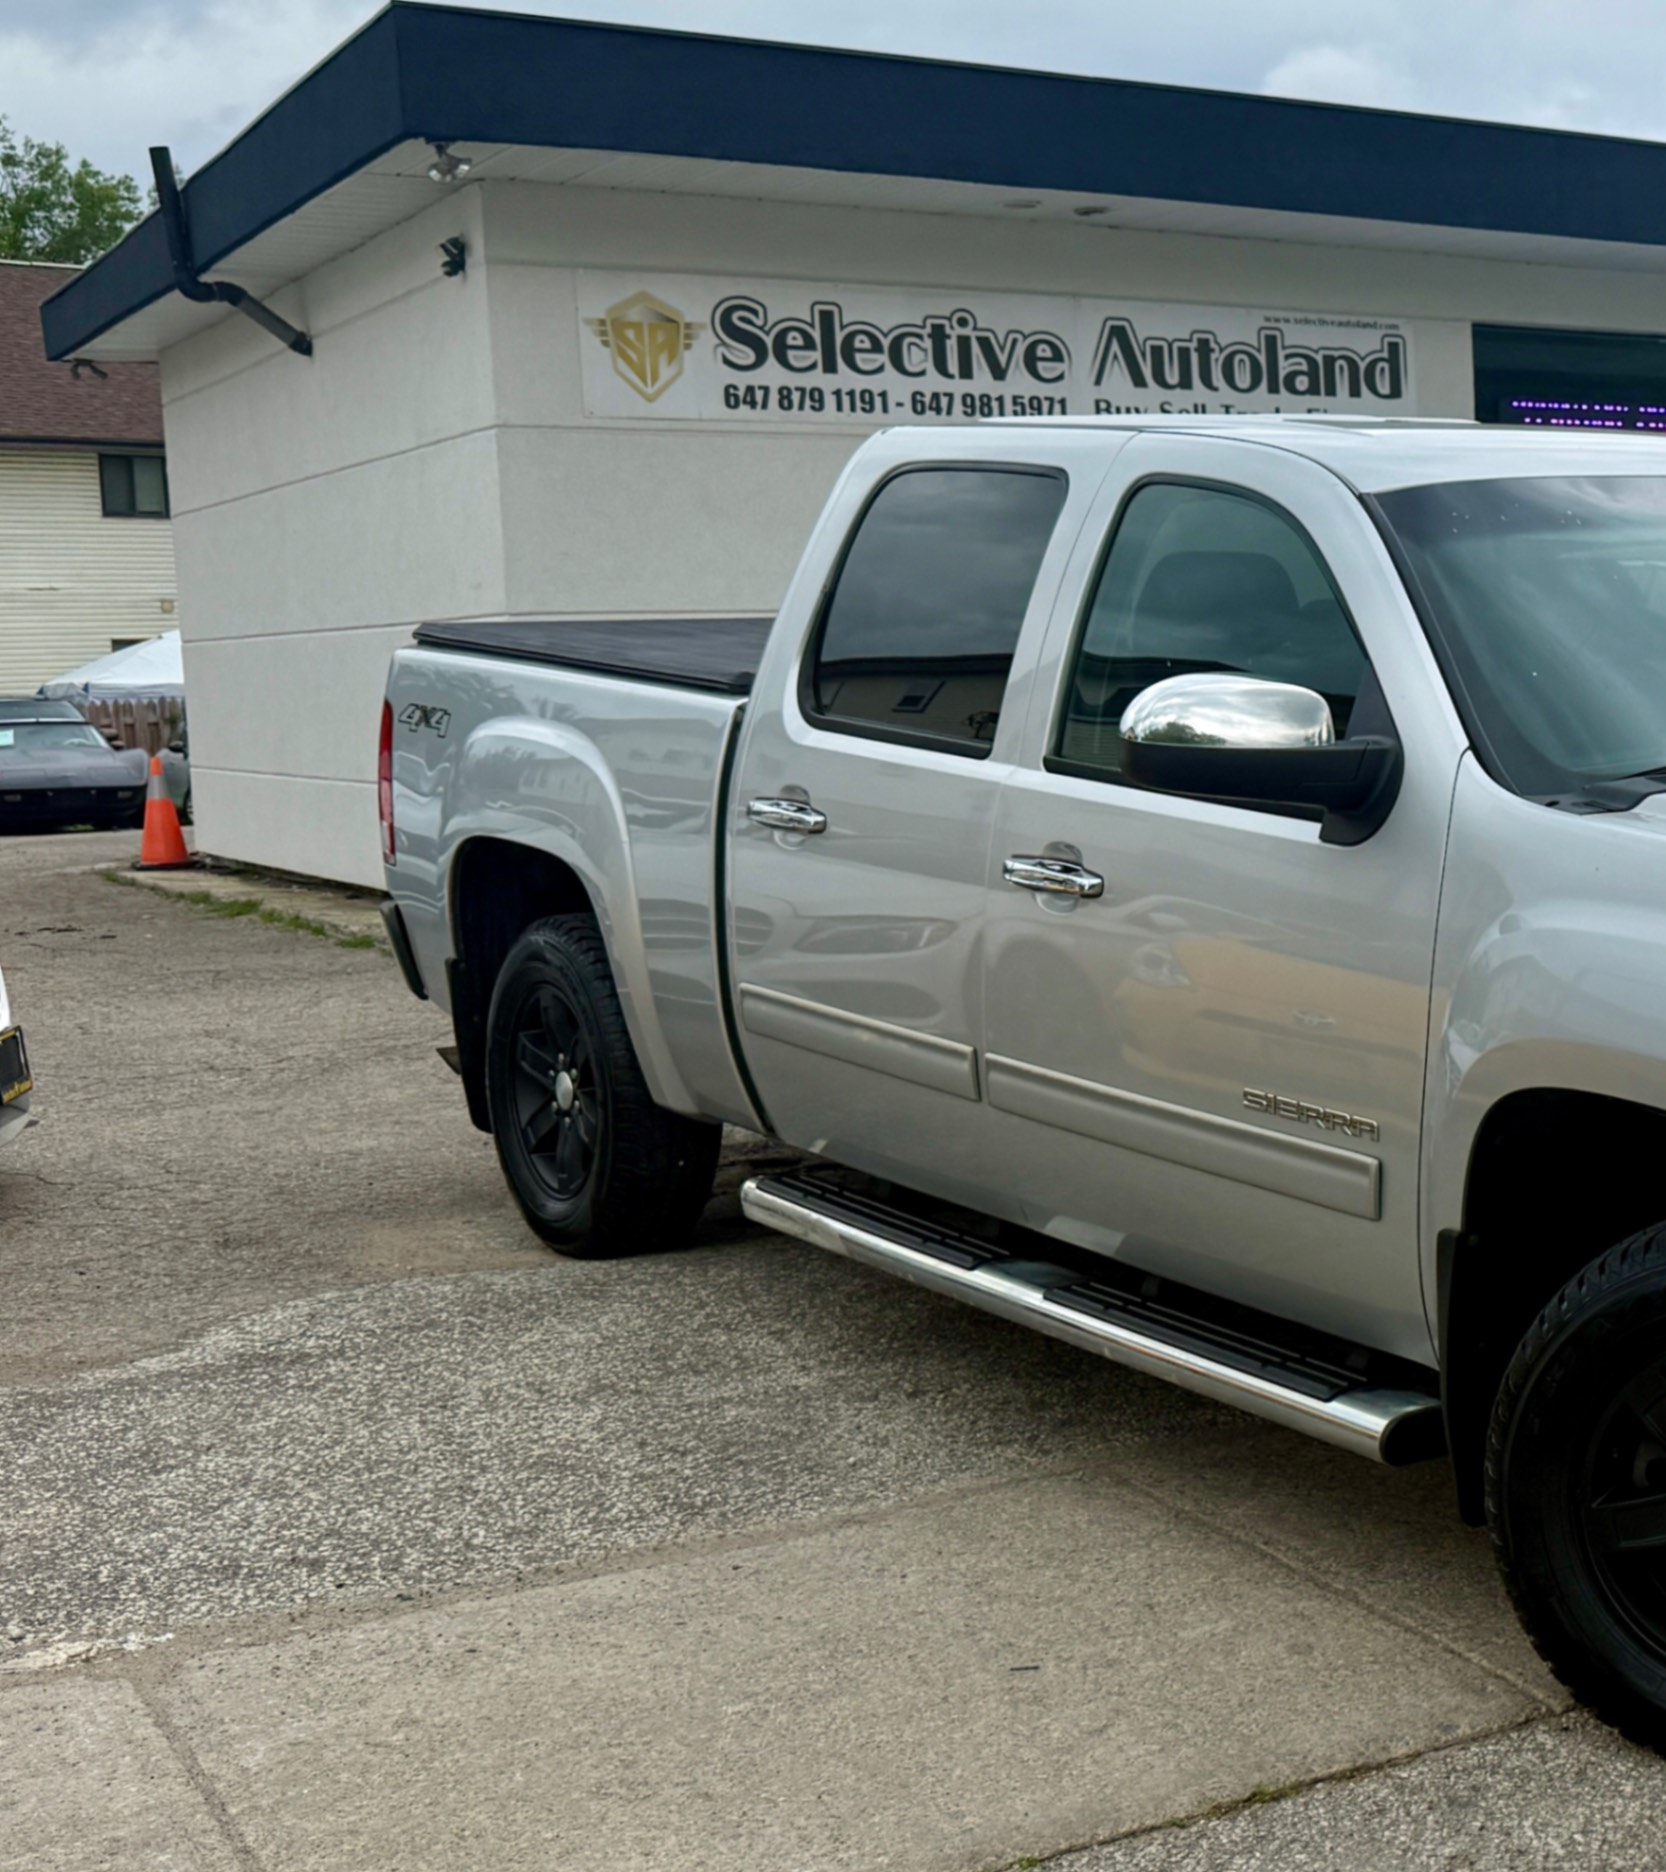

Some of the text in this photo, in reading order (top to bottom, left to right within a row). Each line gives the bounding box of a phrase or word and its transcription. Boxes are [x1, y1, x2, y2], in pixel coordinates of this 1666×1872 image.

[711, 295, 1407, 400] Selective Autoland
[723, 384, 770, 410] 647
[777, 385, 825, 412] 879
[831, 388, 889, 414] 1191
[911, 390, 954, 416] 647
[961, 393, 1006, 418] 981
[1011, 394, 1067, 416] 5971
[1242, 1086, 1381, 1143] SIERRA
